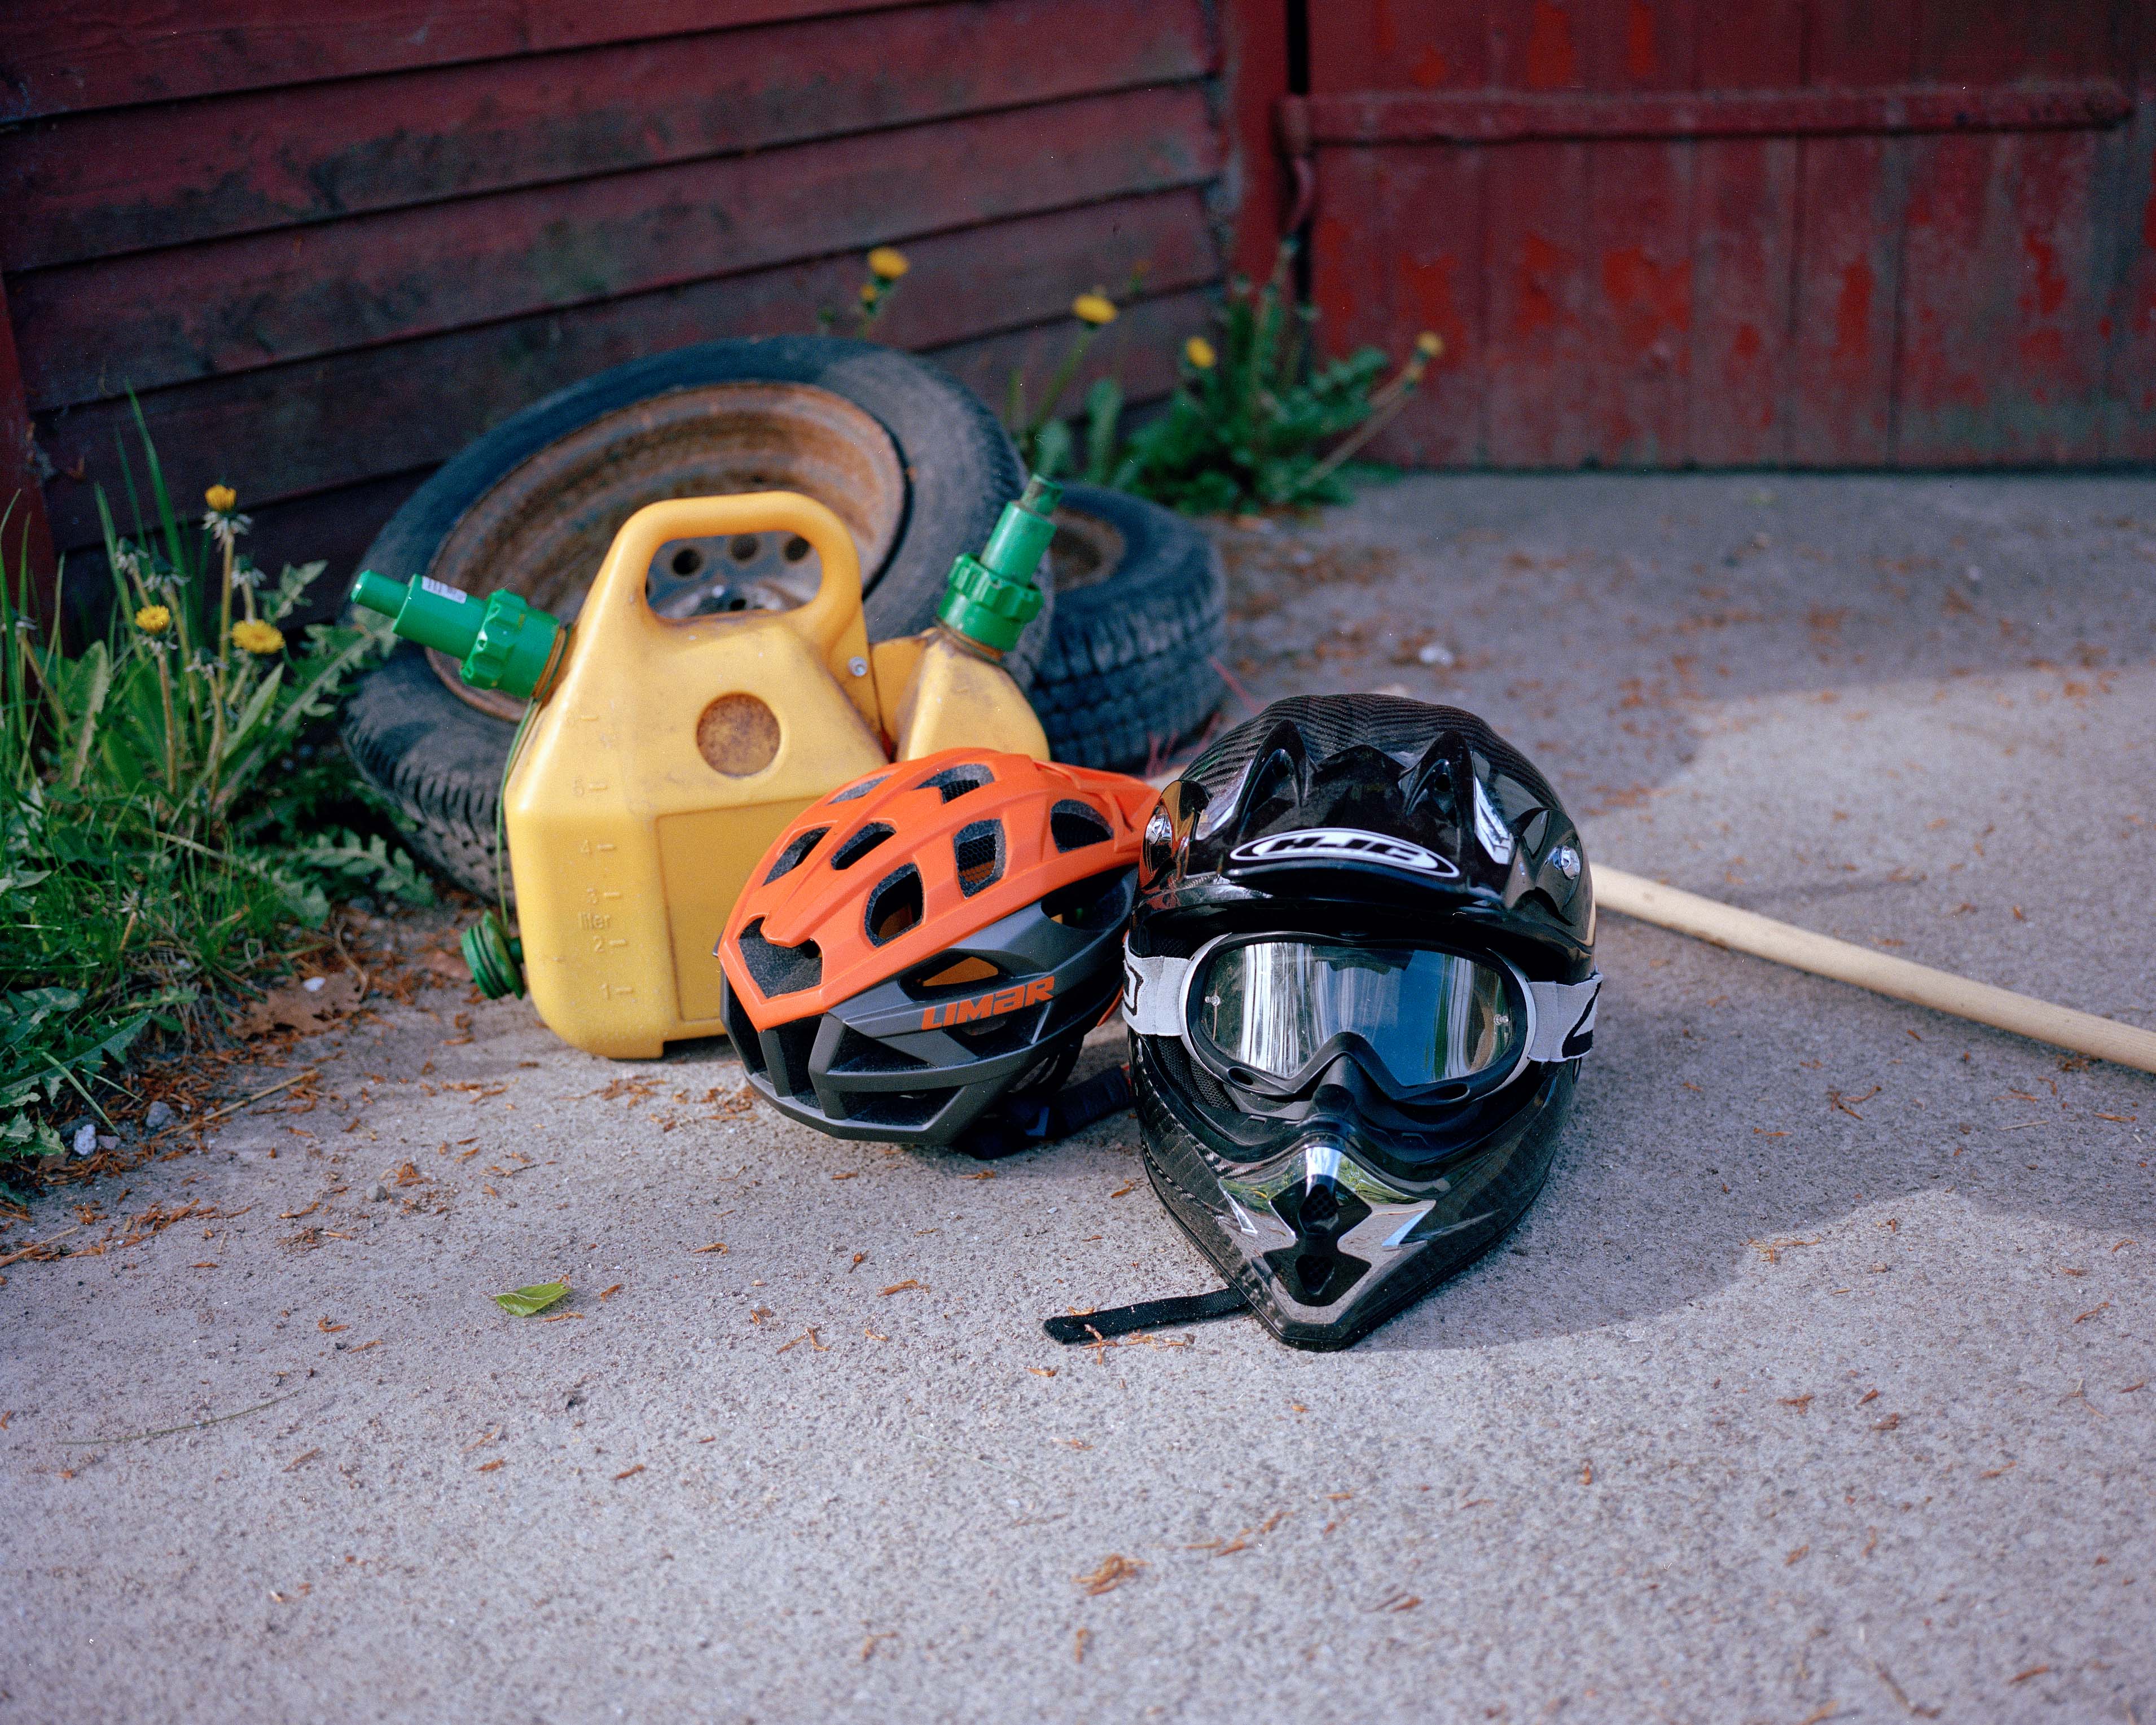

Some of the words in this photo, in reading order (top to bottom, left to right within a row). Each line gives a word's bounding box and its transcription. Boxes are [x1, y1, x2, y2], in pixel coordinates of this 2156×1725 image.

[1266, 837, 1421, 861] HJC
[594, 935, 605, 953] 2
[599, 983, 611, 1000] 1
